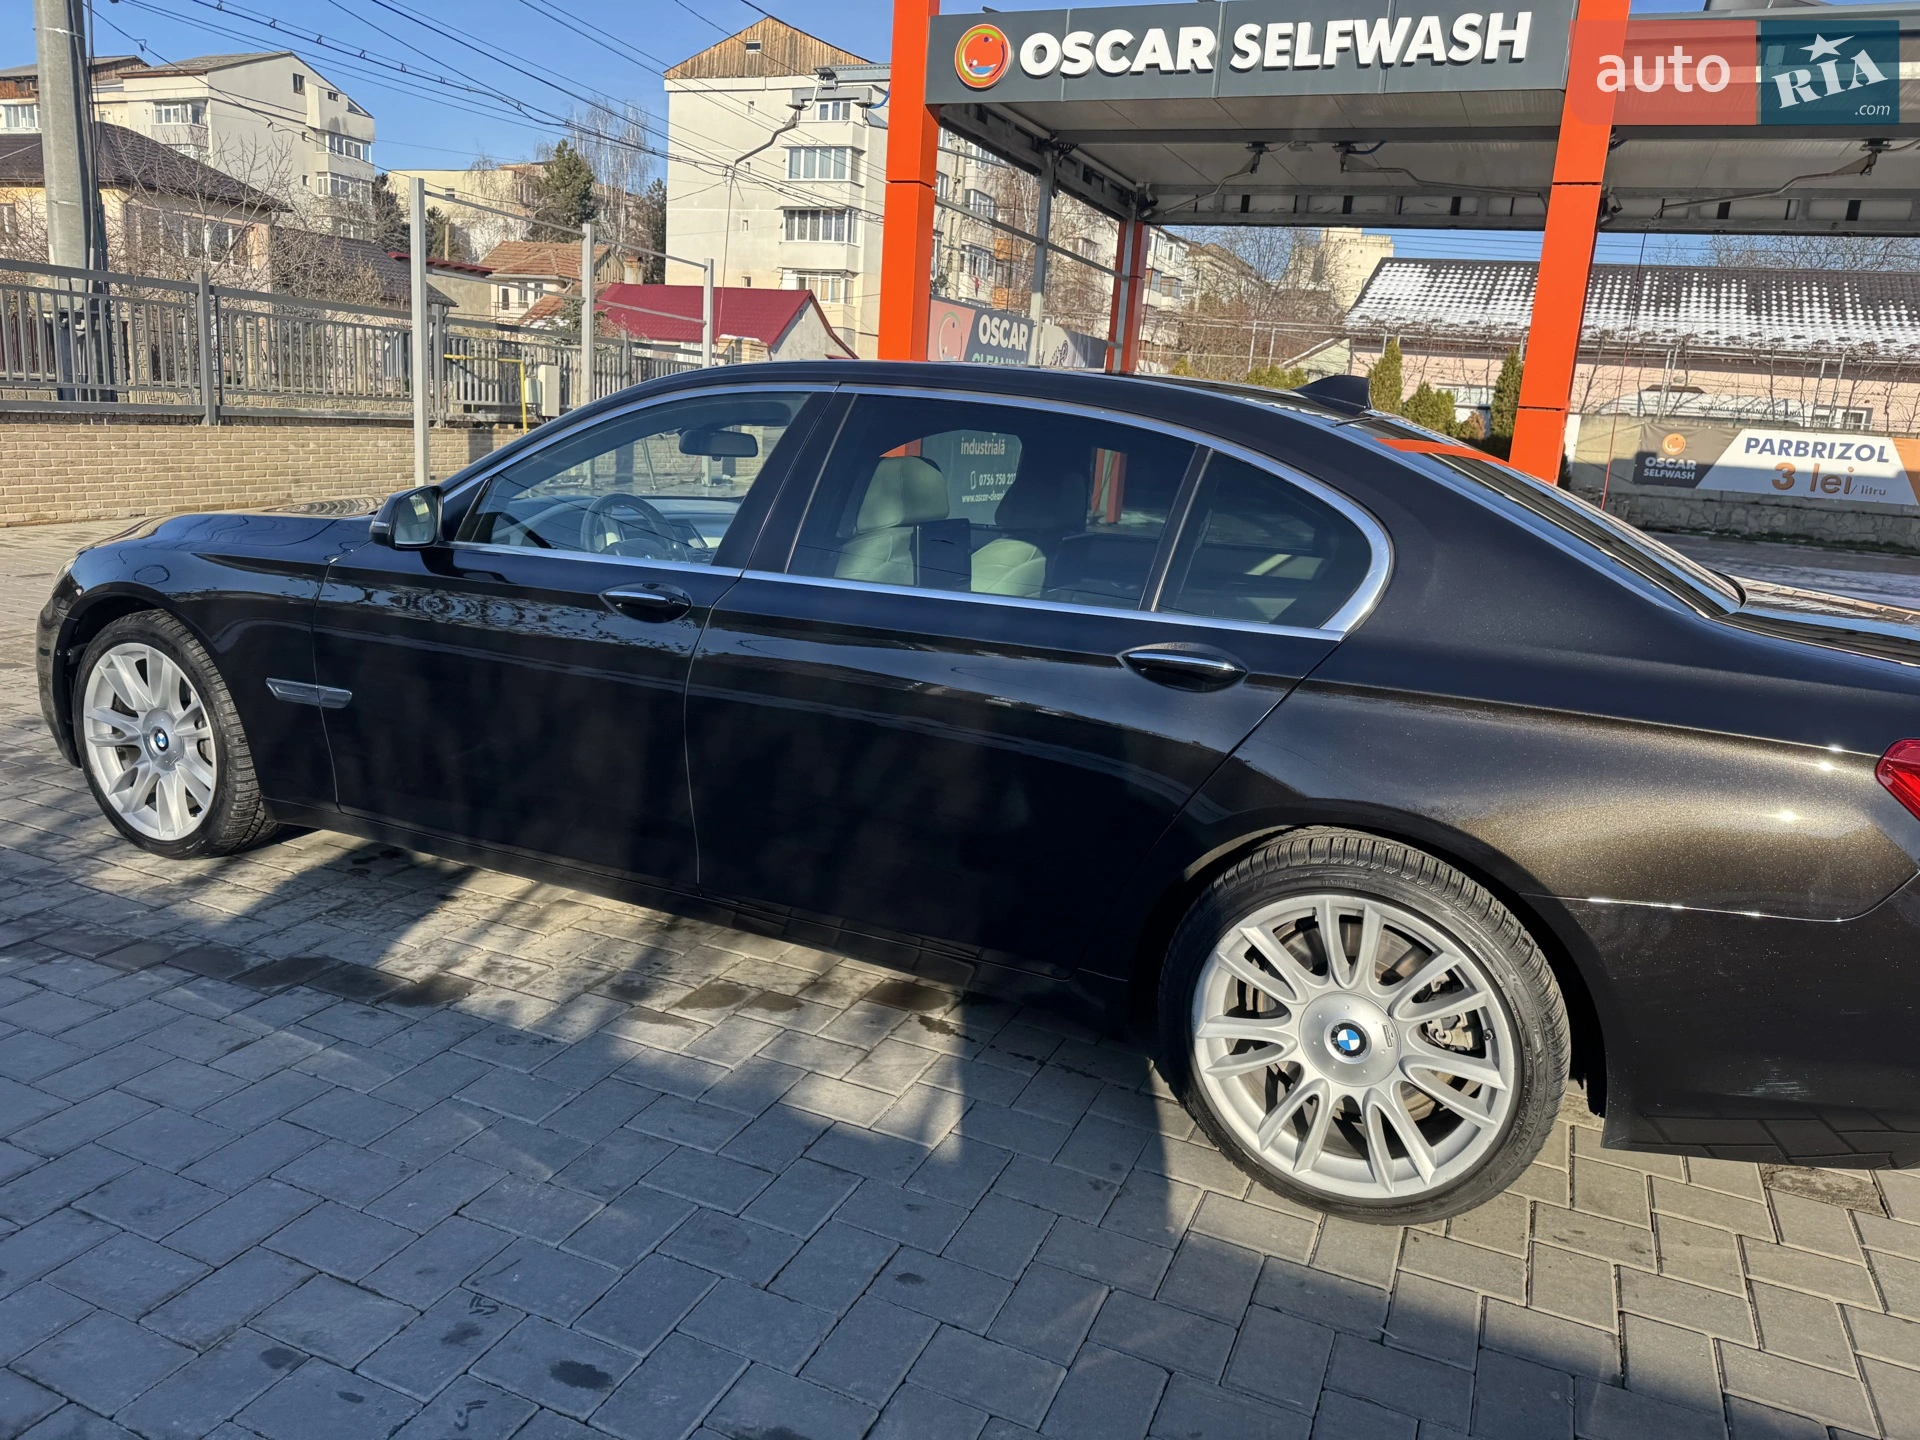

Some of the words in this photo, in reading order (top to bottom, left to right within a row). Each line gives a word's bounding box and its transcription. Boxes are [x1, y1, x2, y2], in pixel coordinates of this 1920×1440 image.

[1019, 25, 1216, 78] OSCAR
[1229, 11, 1533, 73] SELFWASH
[978, 314, 1029, 352] OSCAR
[1768, 409, 1802, 417] ROMNIA
[1744, 437, 1890, 463] PARBRIZOL
[1643, 468, 1696, 481] SELFWASH
[1644, 456, 1697, 471] OSCAR
[1771, 462, 1796, 491] 3
[1809, 463, 1854, 495] lei
